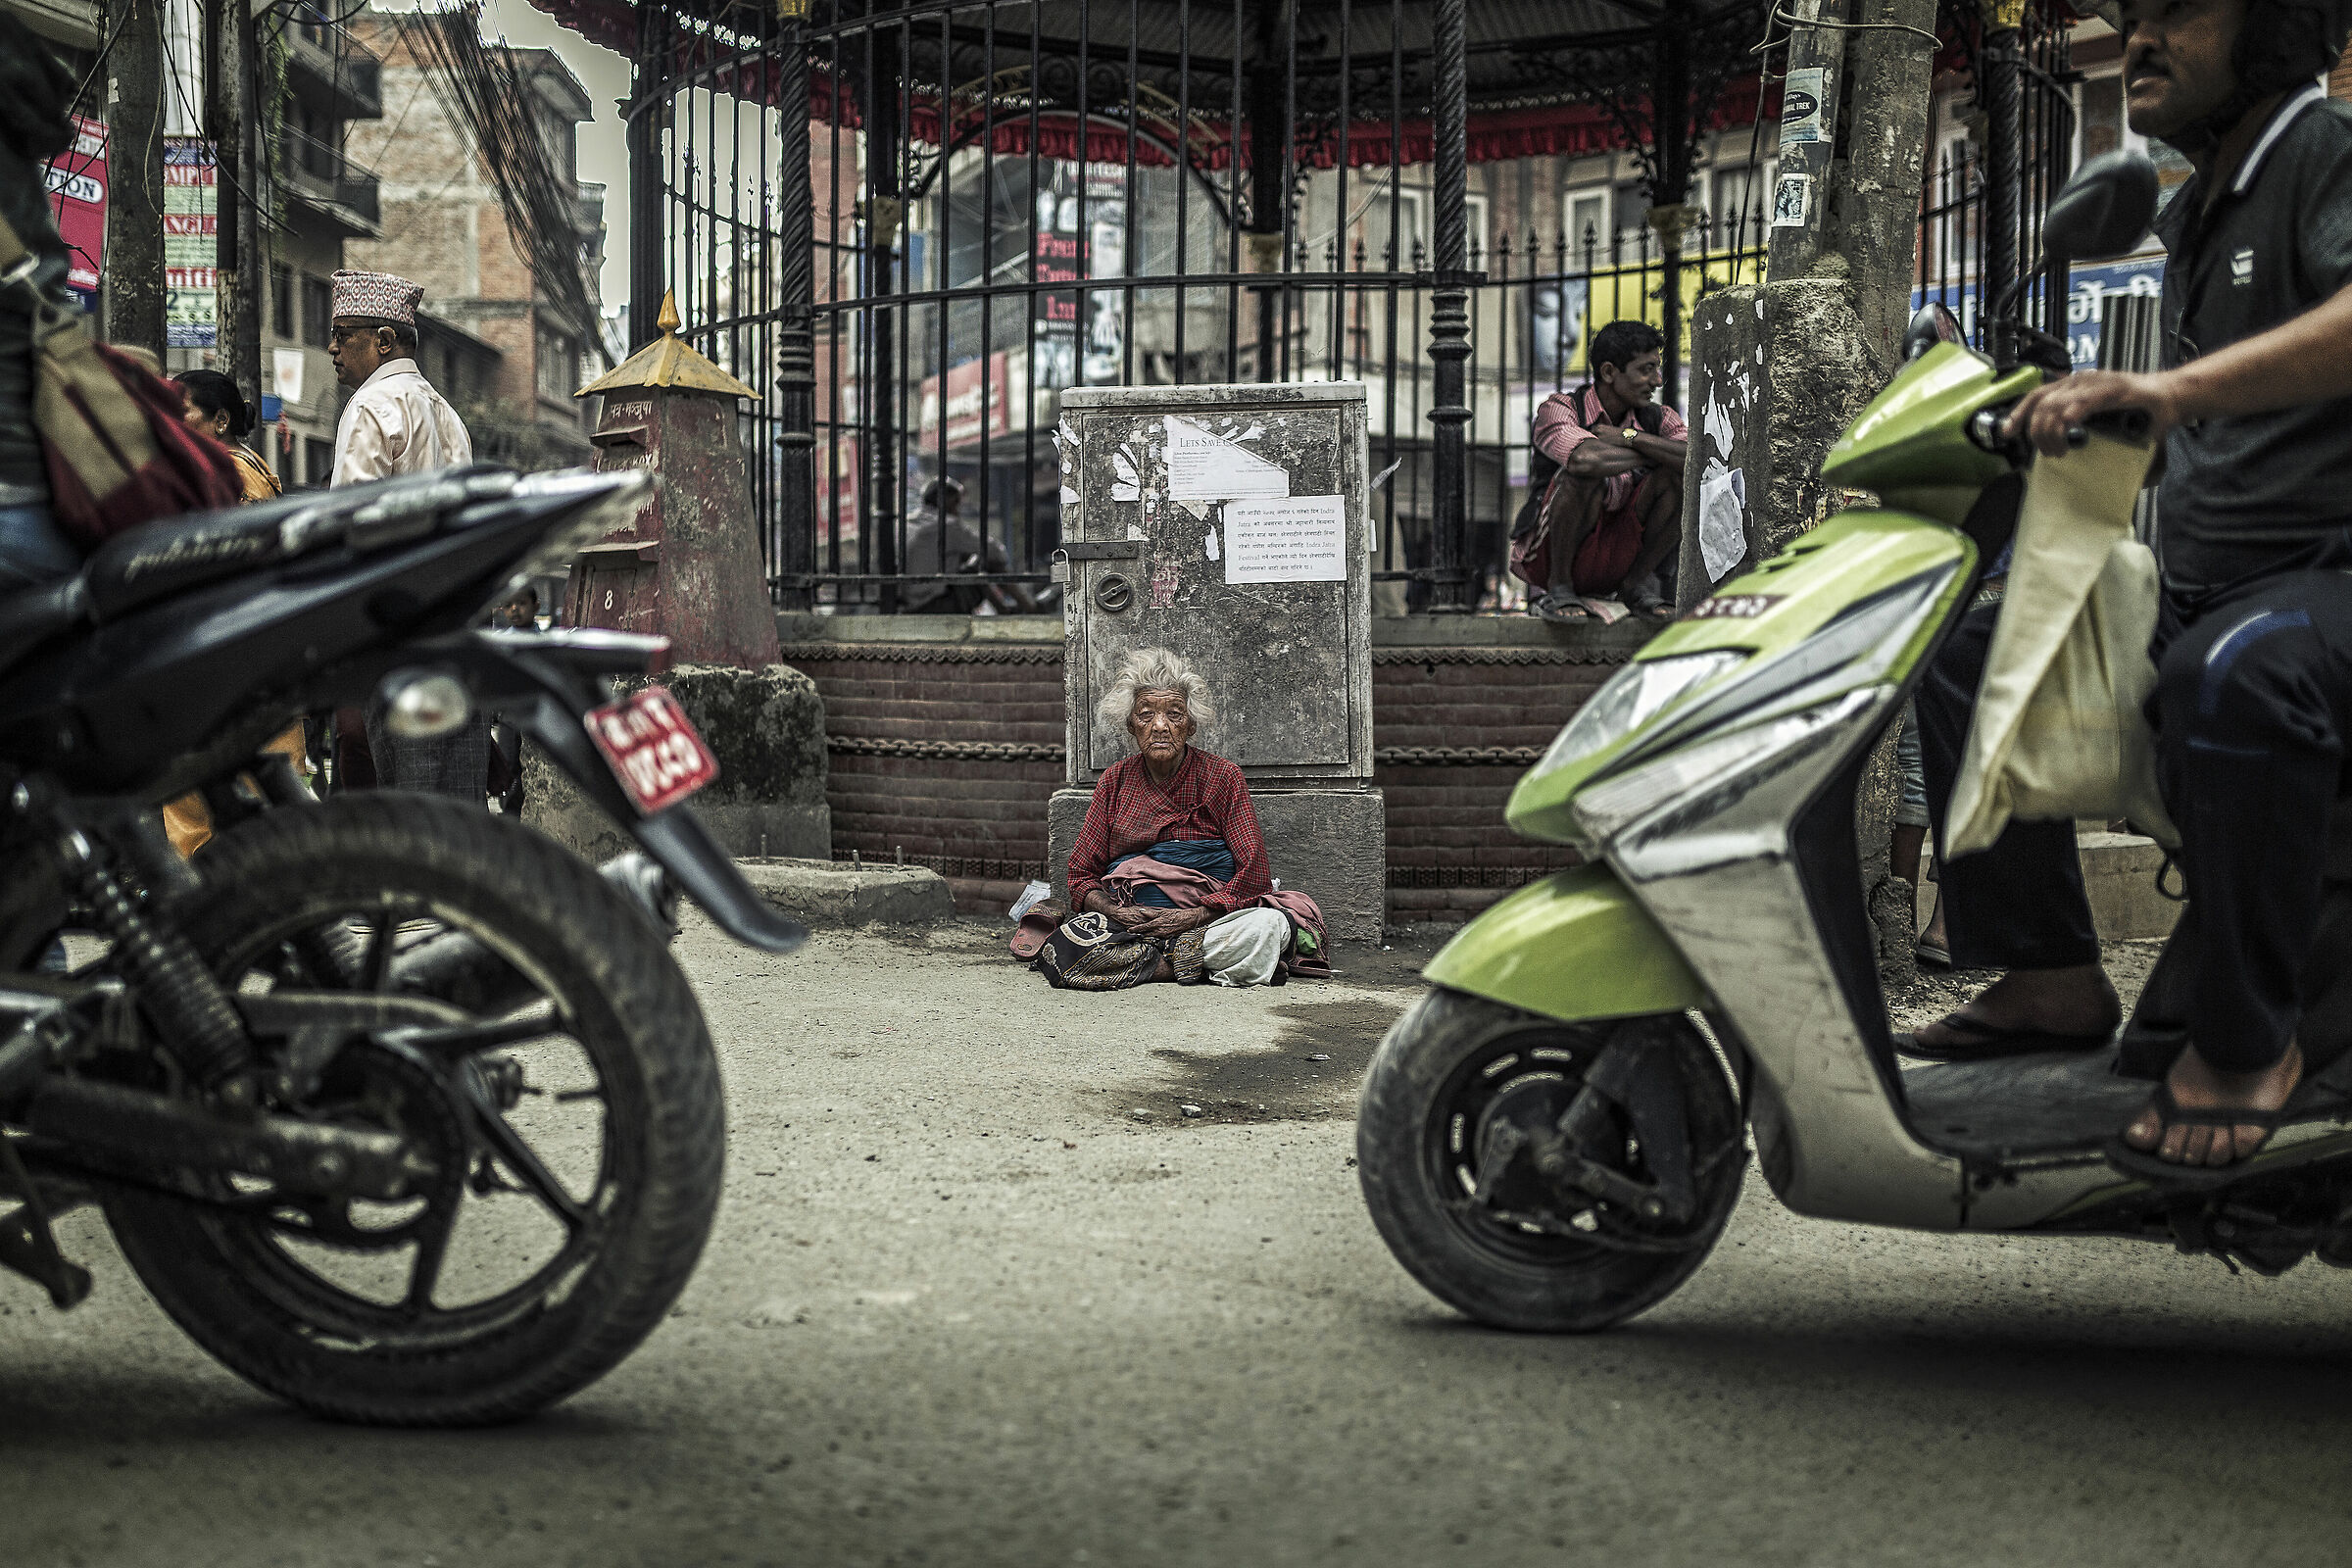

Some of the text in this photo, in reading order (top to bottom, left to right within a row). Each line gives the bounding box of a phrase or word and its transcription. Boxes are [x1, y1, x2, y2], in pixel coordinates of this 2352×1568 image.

[1796, 101, 1811, 110] TREK
[1180, 438, 1200, 447] LETS
[1201, 437, 1221, 448] SAVE
[604, 589, 613, 611] 8
